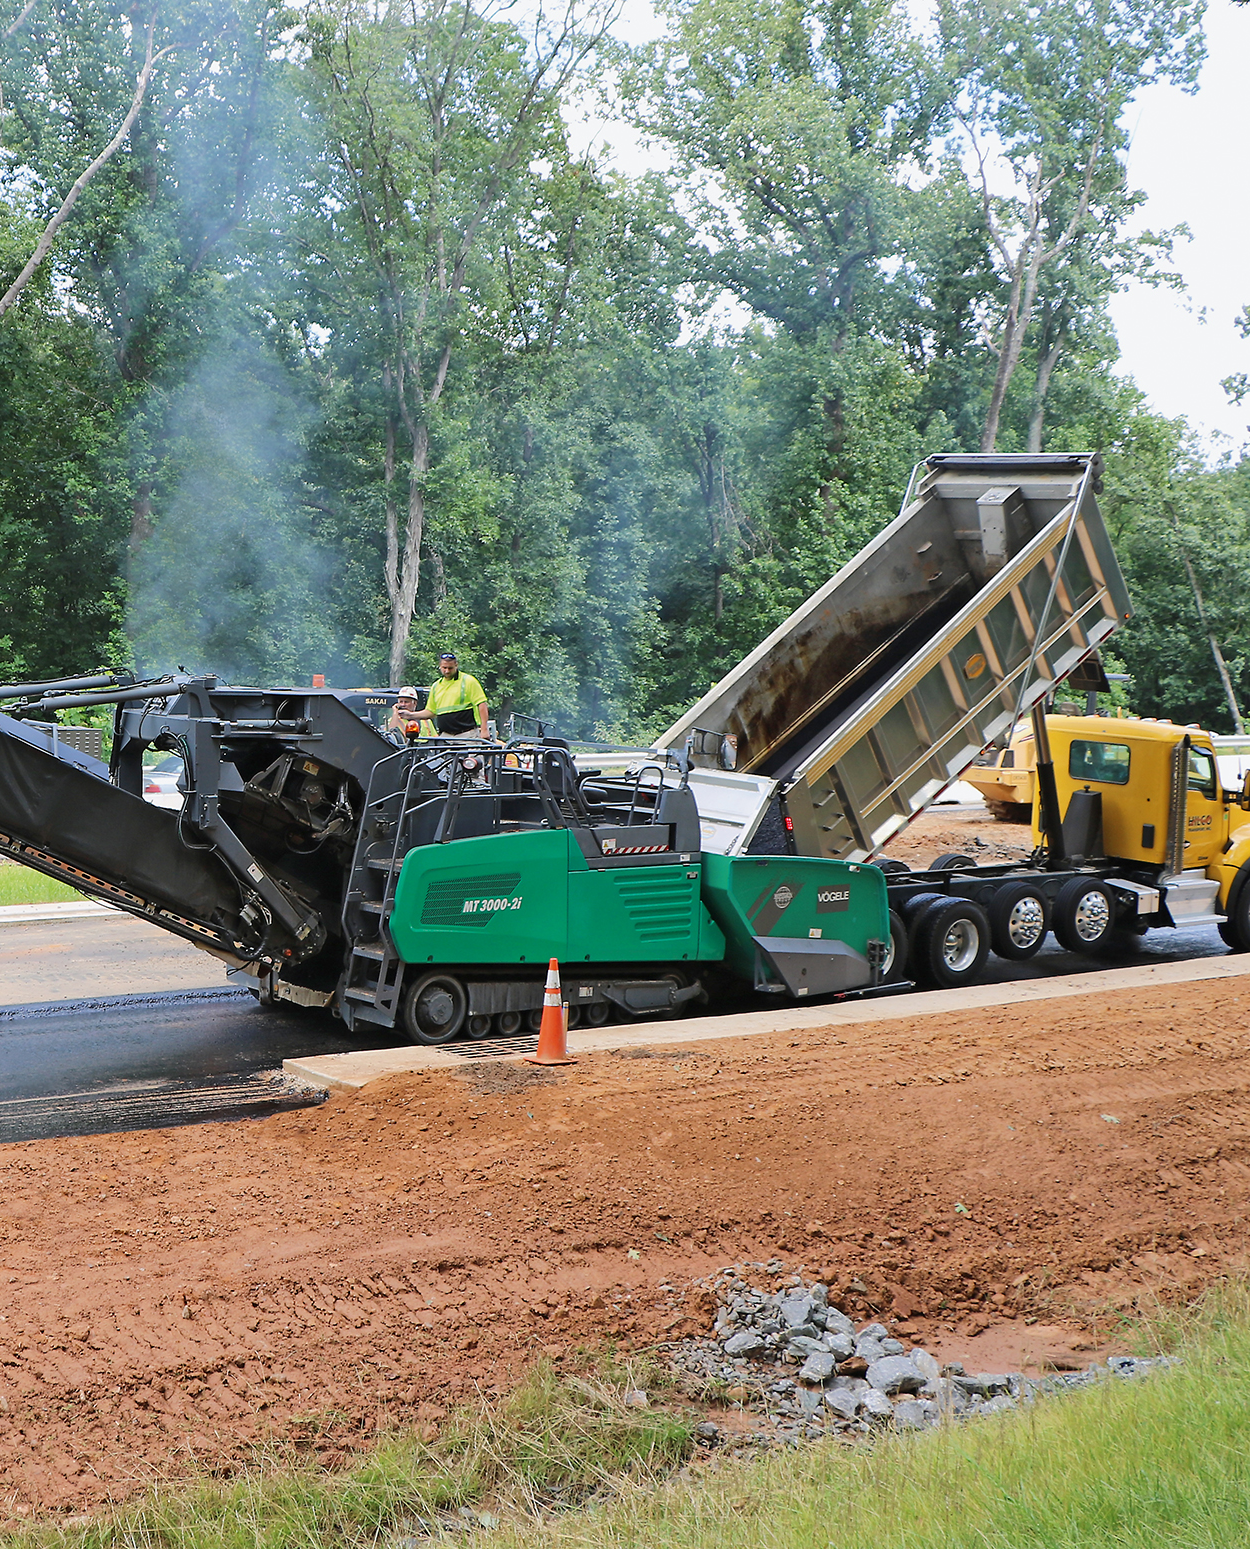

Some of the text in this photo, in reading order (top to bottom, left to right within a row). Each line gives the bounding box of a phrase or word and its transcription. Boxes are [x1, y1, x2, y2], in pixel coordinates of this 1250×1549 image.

[817, 890, 850, 903] VÖGELE
[462, 896, 523, 913] MT 3000-2i
